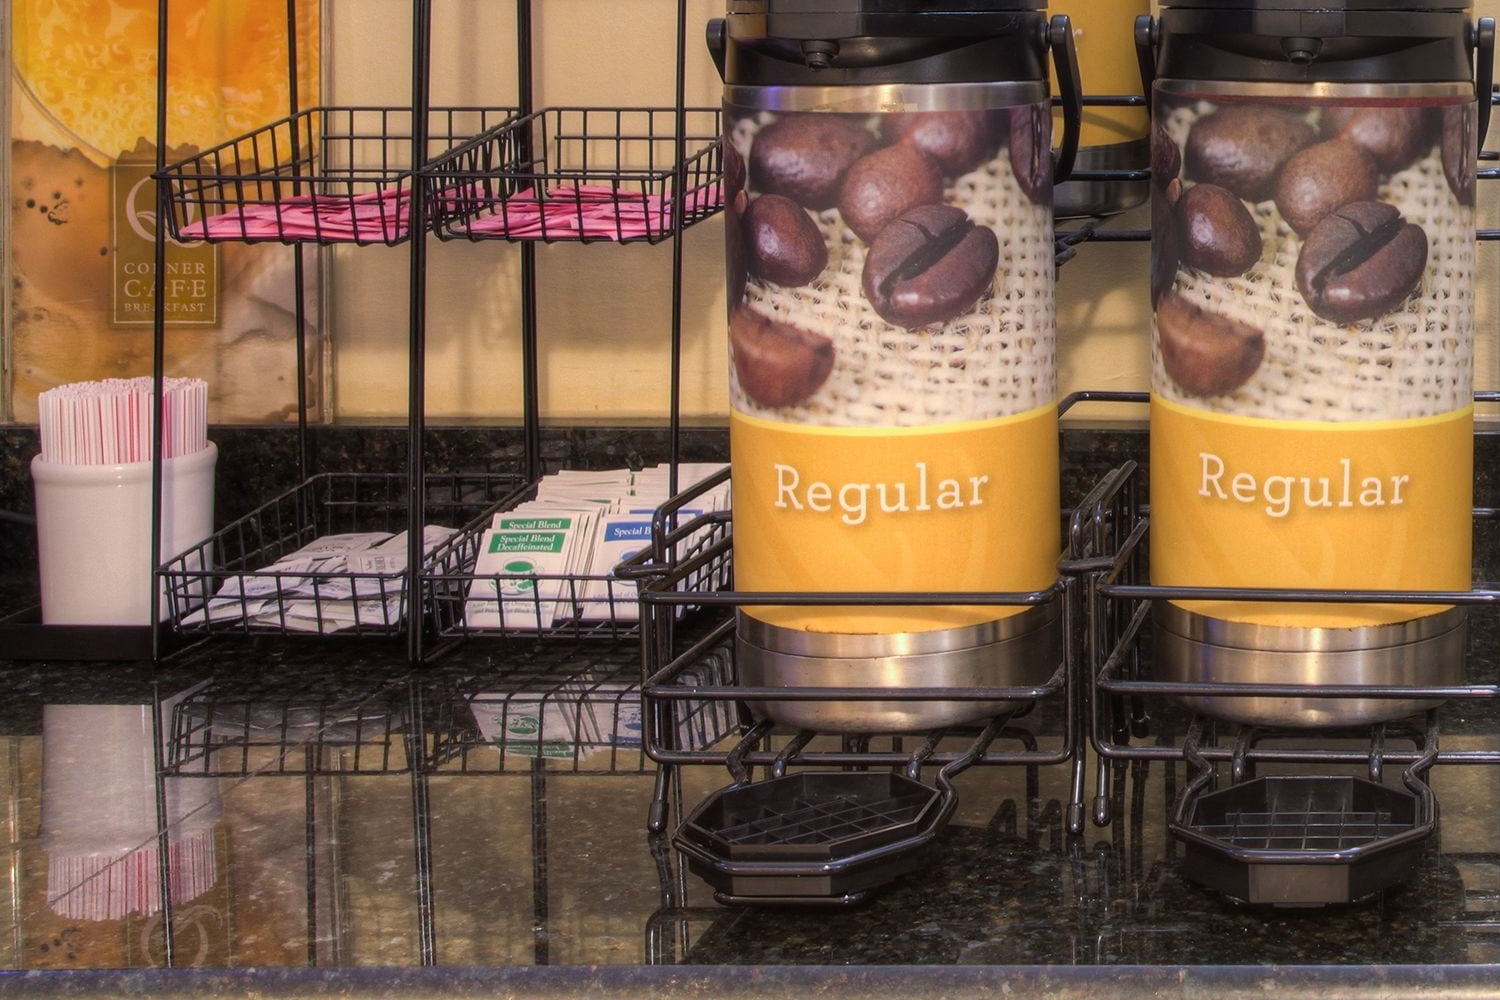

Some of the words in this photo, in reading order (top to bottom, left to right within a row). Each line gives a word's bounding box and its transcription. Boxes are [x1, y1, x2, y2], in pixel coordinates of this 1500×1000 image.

[124, 262, 206, 275] CONER
[124, 303, 206, 313] BREKFAST
[1198, 452, 1409, 518] Regular
[773, 462, 989, 526] Regular
[509, 521, 536, 530] Special
[537, 520, 562, 529] Blend
[613, 526, 643, 537] Special
[500, 534, 530, 544] Special
[530, 534, 556, 543] Blend
[497, 543, 554, 552] Decaffeinated
